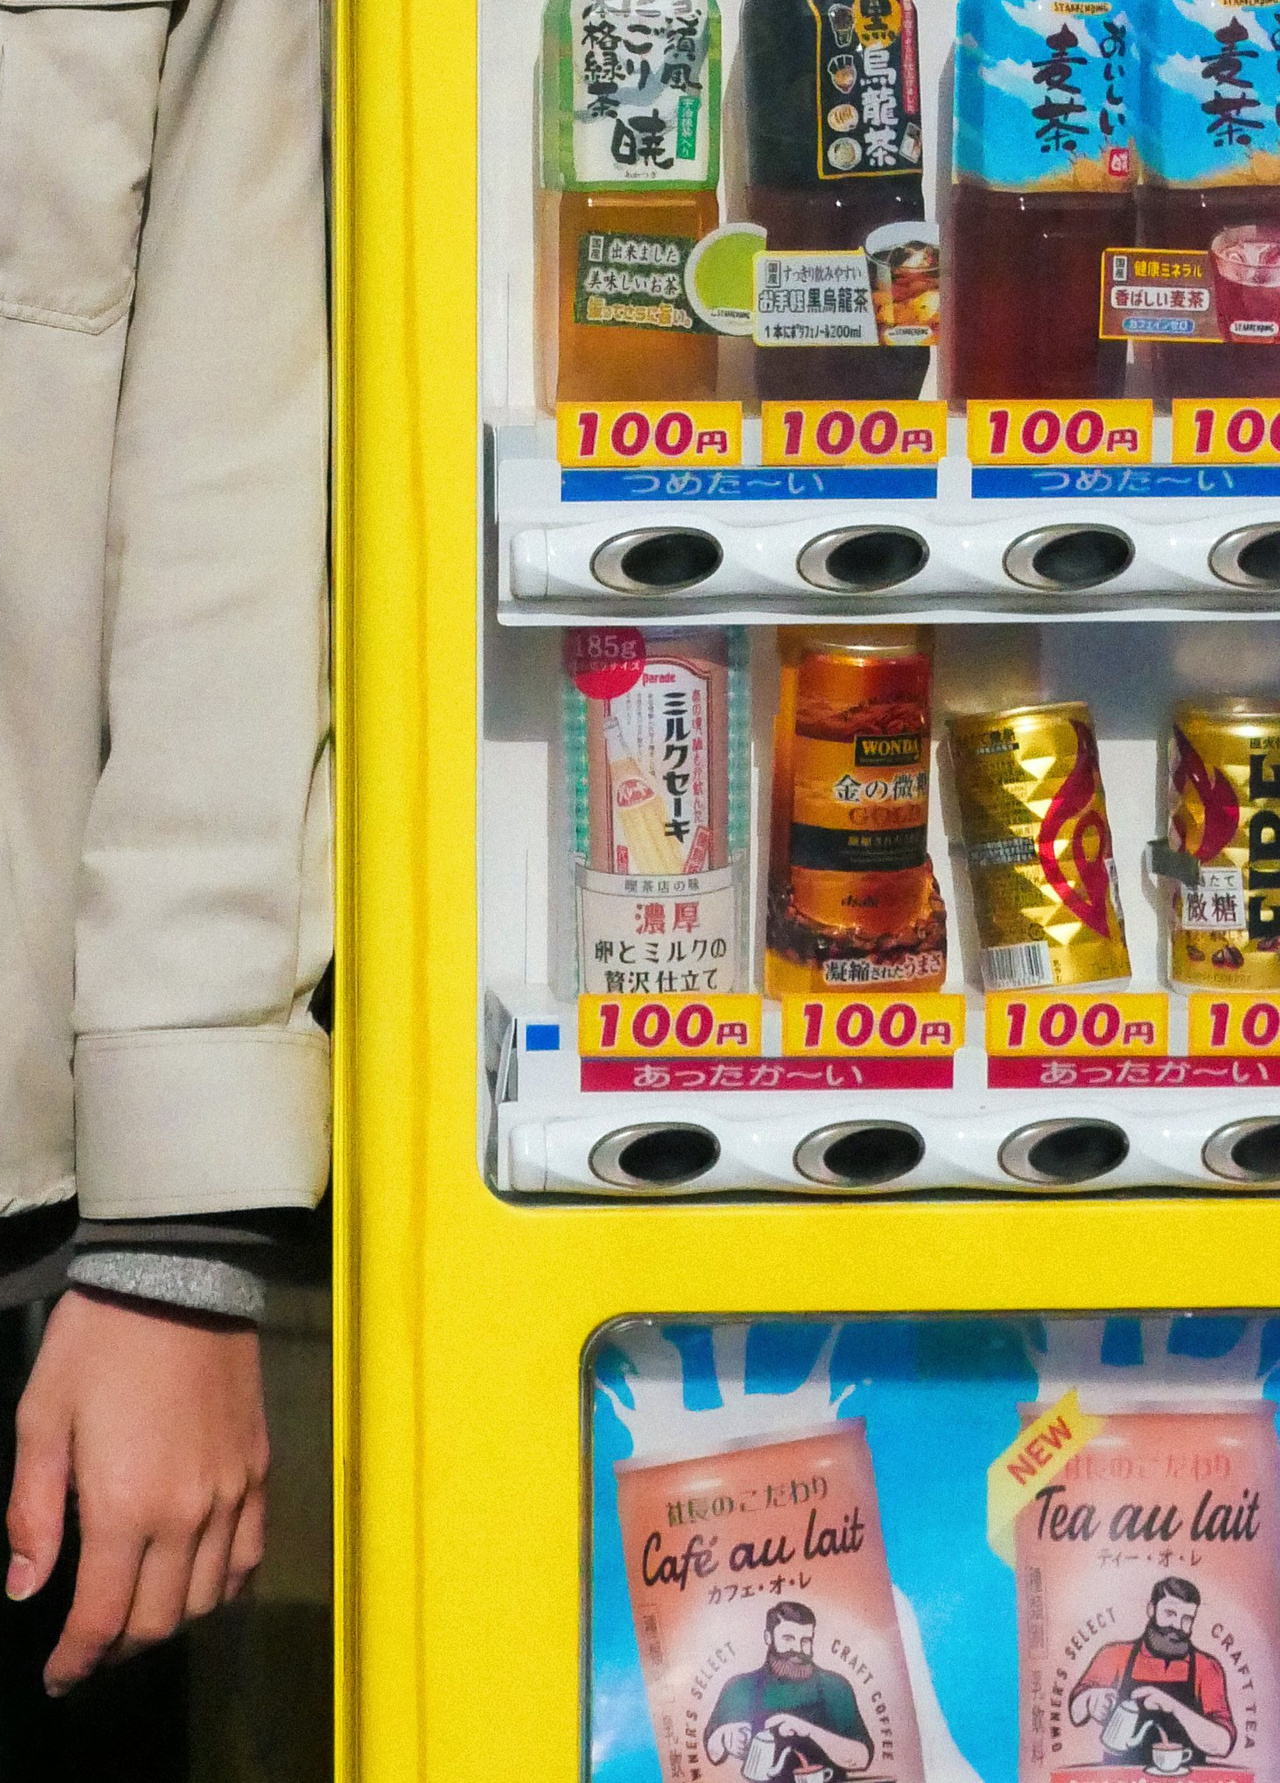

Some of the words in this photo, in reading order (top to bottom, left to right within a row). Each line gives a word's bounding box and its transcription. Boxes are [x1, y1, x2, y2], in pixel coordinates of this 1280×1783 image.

[1032, 22, 1090, 153] 麦茶
[1099, 21, 1127, 136] おいしい
[1200, 16, 1265, 148] 麦茶
[610, 241, 679, 263] 出来ました
[1134, 261, 1202, 278] 健康ミネラル
[587, 268, 680, 296] 美味しいお茶
[1115, 289, 1205, 308] 香ばしい麦茶
[577, 411, 728, 457] 100円
[783, 410, 934, 456] 100円
[988, 409, 1139, 454] 100円
[1193, 408, 1280, 454] 10
[662, 692, 690, 844] ミルクセーキ
[624, 878, 699, 894] 喫茶店の味
[1187, 892, 1237, 923] 微糖
[635, 901, 700, 934] 濃厚
[595, 938, 727, 964] 卵とミルクの
[826, 953, 941, 982] 凝縮されたうまさ
[605, 968, 717, 993] 贅沢仕立て
[599, 1003, 748, 1048] 100円
[803, 1003, 952, 1048] 100円
[1006, 1002, 1156, 1047] 100円
[1007, 1415, 1072, 1486] NEW
[1035, 1484, 1101, 1542] Tea
[1109, 1503, 1183, 1542] au
[1190, 1488, 1260, 1543] lait
[642, 1530, 720, 1592] Café
[729, 1535, 796, 1572] au
[803, 1506, 865, 1560] lait
[1065, 1606, 1117, 1661] SELECT
[690, 1640, 737, 1701] SELECT
[1211, 1623, 1254, 1691] CRAFT
[1244, 1704, 1257, 1749] TEA
[831, 1638, 875, 1686] CRAFT
[871, 1691, 895, 1761] COFFEE
